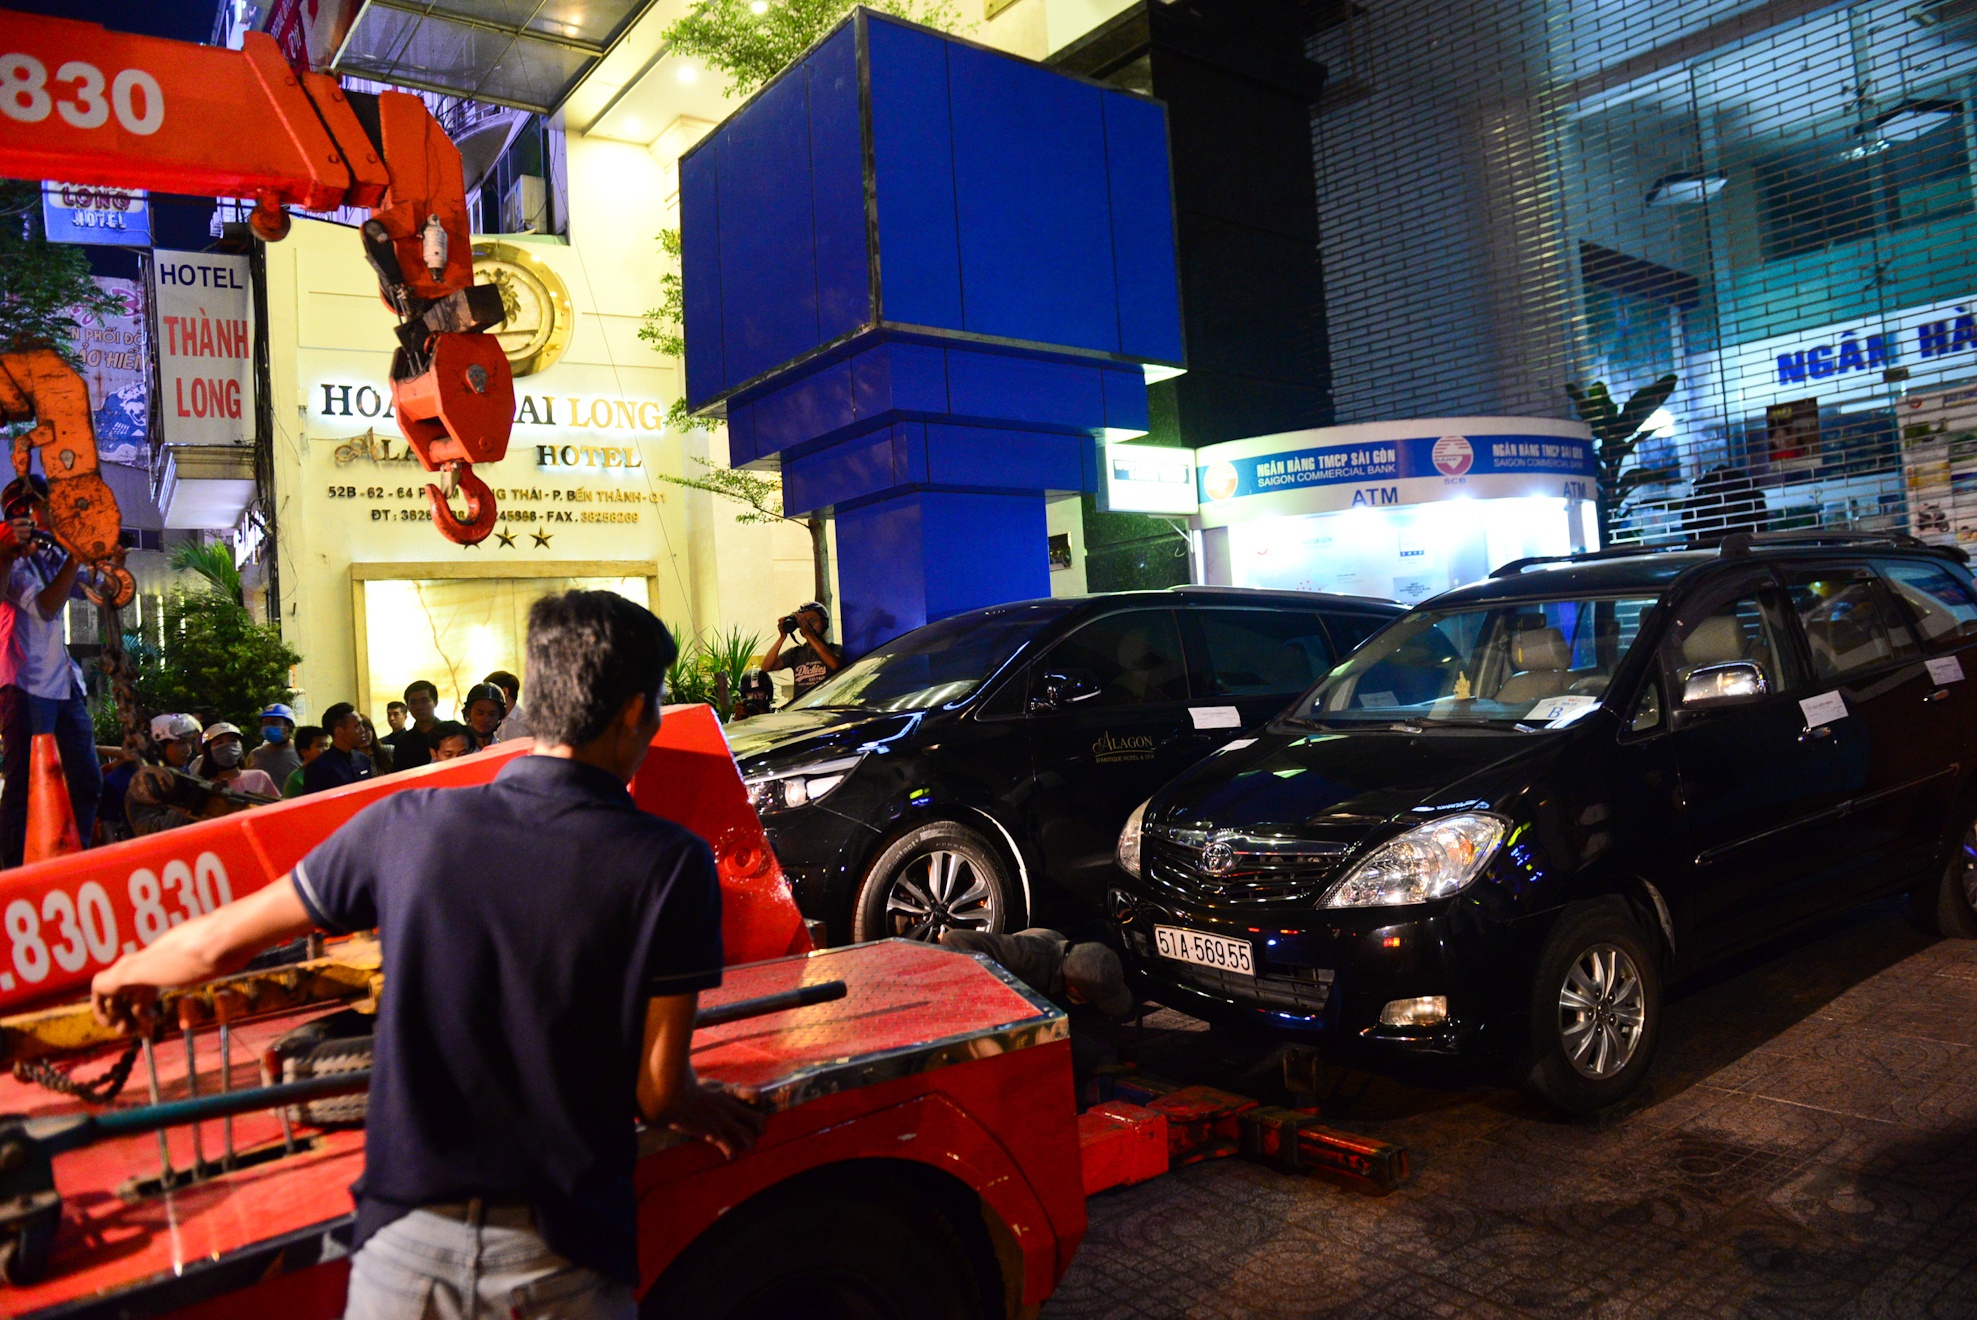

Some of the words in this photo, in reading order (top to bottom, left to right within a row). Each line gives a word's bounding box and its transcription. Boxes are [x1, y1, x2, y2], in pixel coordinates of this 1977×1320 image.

[61, 185, 131, 211] LONG
[72, 210, 127, 229] HOTEL
[160, 263, 243, 289] HOTEL
[163, 307, 250, 359] THÀNH
[1776, 330, 1900, 386] NGÂN
[175, 377, 242, 420] LONG
[566, 396, 664, 431] LONG
[535, 444, 643, 469] HOTEL
[1256, 460, 1285, 478] NGÂN
[1287, 456, 1316, 474] HÀNG
[1318, 453, 1348, 470] TMCP
[1350, 449, 1370, 466] SÀI
[1372, 447, 1396, 464] GÒN
[1258, 474, 1295, 487] SAIGON
[1297, 465, 1365, 483] COMMERCIAL
[1367, 464, 1396, 475] BANK
[511, 485, 543, 501] THÁI
[566, 486, 593, 502] BẾN
[1351, 486, 1399, 507] ATM
[1563, 481, 1587, 498] ATM
[1547, 706, 1564, 719] B
[1092, 730, 1153, 754] ALAGON
